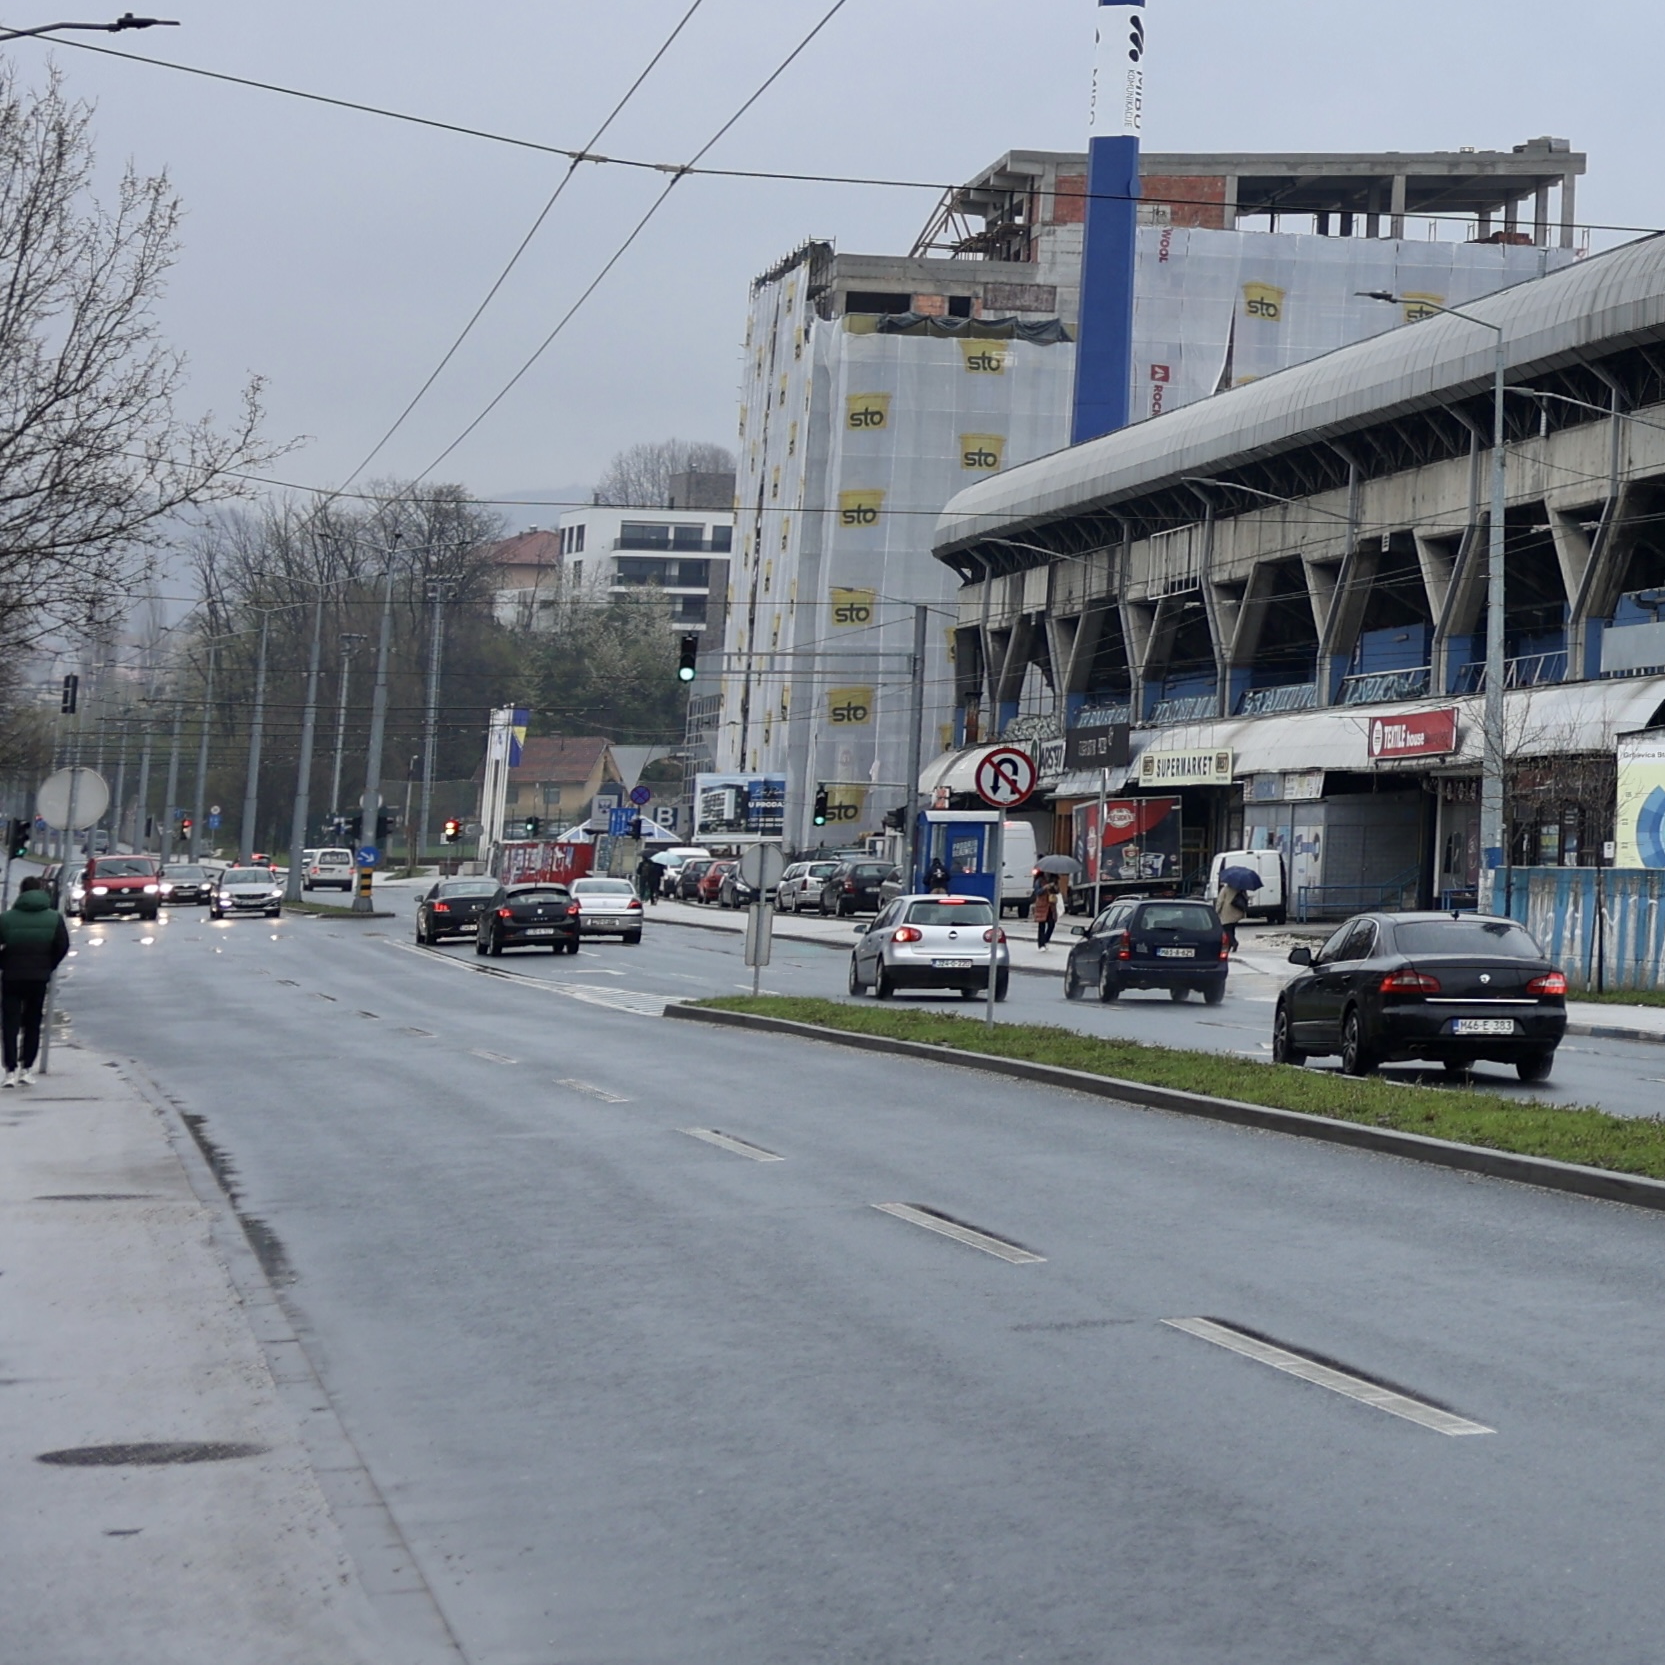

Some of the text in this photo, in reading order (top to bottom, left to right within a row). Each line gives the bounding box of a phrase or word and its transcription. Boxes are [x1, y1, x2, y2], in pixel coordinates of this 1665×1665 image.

[1123, 68, 1136, 128] KOMUNIKACIJE
[1246, 297, 1278, 319] sto
[1406, 305, 1434, 323] st
[967, 354, 1000, 372] sto
[849, 406, 885, 427] sto
[964, 447, 998, 467] sto
[842, 503, 878, 524] sto
[835, 603, 870, 623] sto
[831, 702, 868, 723] sto
[1383, 724, 1407, 750] TEXTILE
[1406, 731, 1425, 748] house
[1156, 755, 1213, 778] SUPERMARKET
[825, 801, 858, 821] sto
